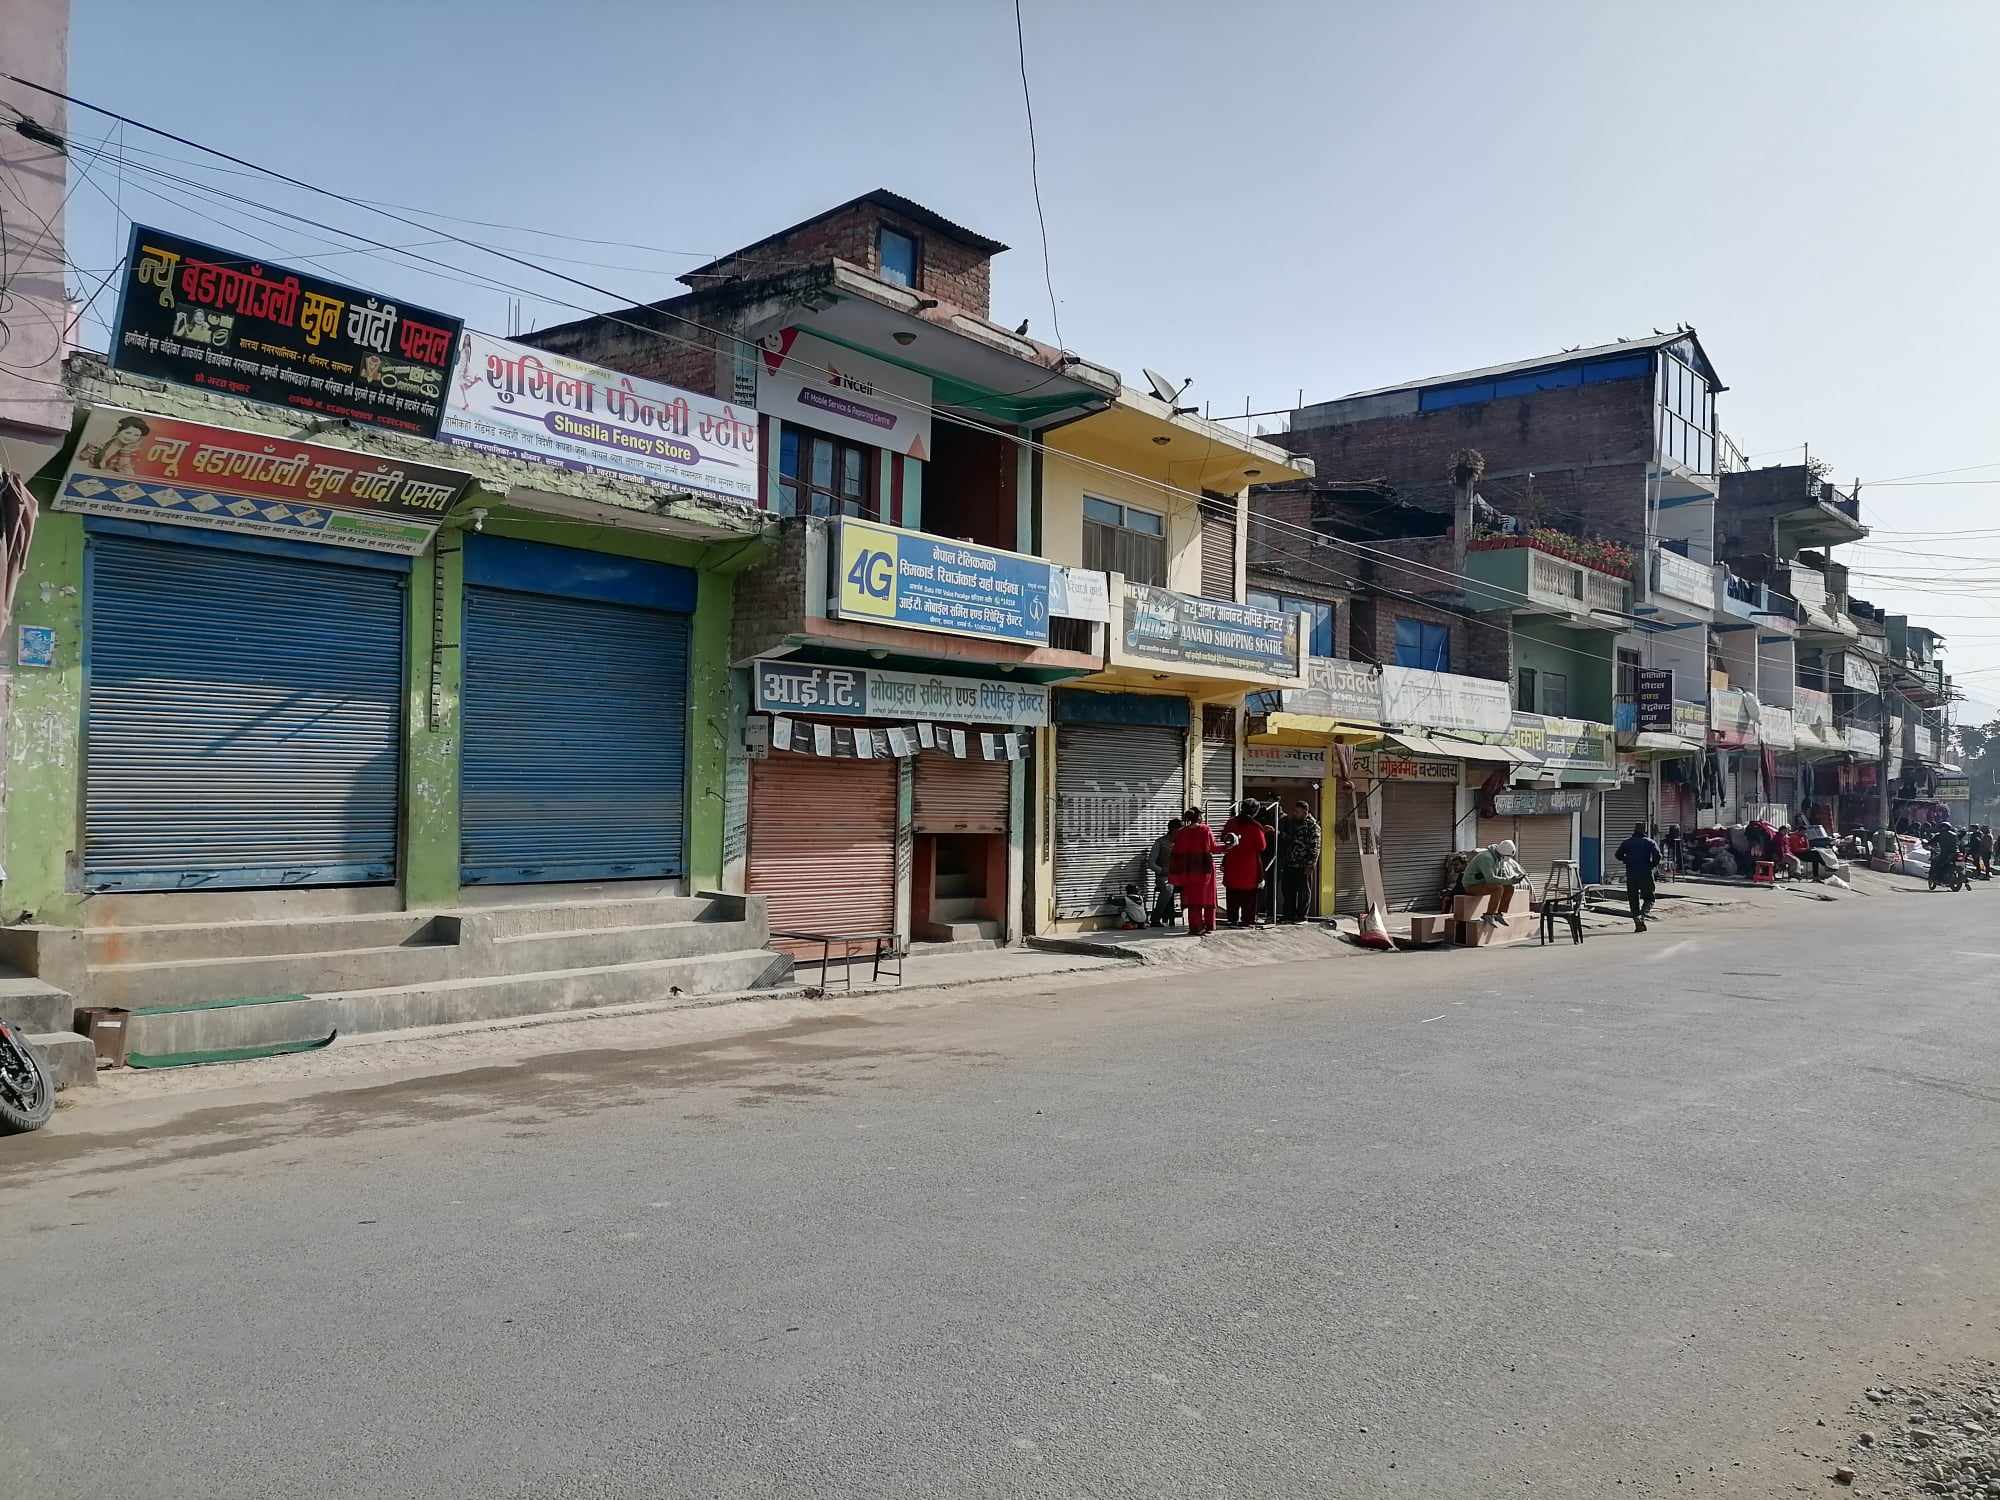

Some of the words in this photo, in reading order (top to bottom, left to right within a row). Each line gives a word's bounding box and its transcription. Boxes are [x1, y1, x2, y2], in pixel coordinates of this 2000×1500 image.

[138, 245, 180, 309] न्यू
[301, 290, 344, 346] सुन
[347, 299, 398, 352] चाँदी
[400, 320, 453, 367] पसल
[485, 354, 594, 413] शुसिला
[605, 378, 689, 437] फेन्सी
[698, 405, 755, 452] स्टोर
[843, 374, 873, 395] Ncell
[554, 416, 609, 442] Shusila
[612, 430, 653, 454] Fency
[656, 440, 692, 461] Store
[148, 436, 191, 478] न्यू
[305, 463, 353, 498] सुन
[351, 464, 405, 503] चाँदी
[400, 479, 456, 511] पसल
[848, 549, 894, 600] 4G
[933, 546, 956, 564] नेपाल
[1124, 584, 1150, 600] NEW
[1180, 626, 1213, 643] AANAND
[1214, 631, 1254, 652] SHOPPING
[1255, 638, 1283, 656] SENTRE
[763, 669, 861, 708] आई.टि.
[919, 677, 952, 707] सर्भिस
[954, 686, 978, 707] एण्ड
[1017, 685, 1044, 713] सेन्टर
[1352, 755, 1374, 775] न्यू
